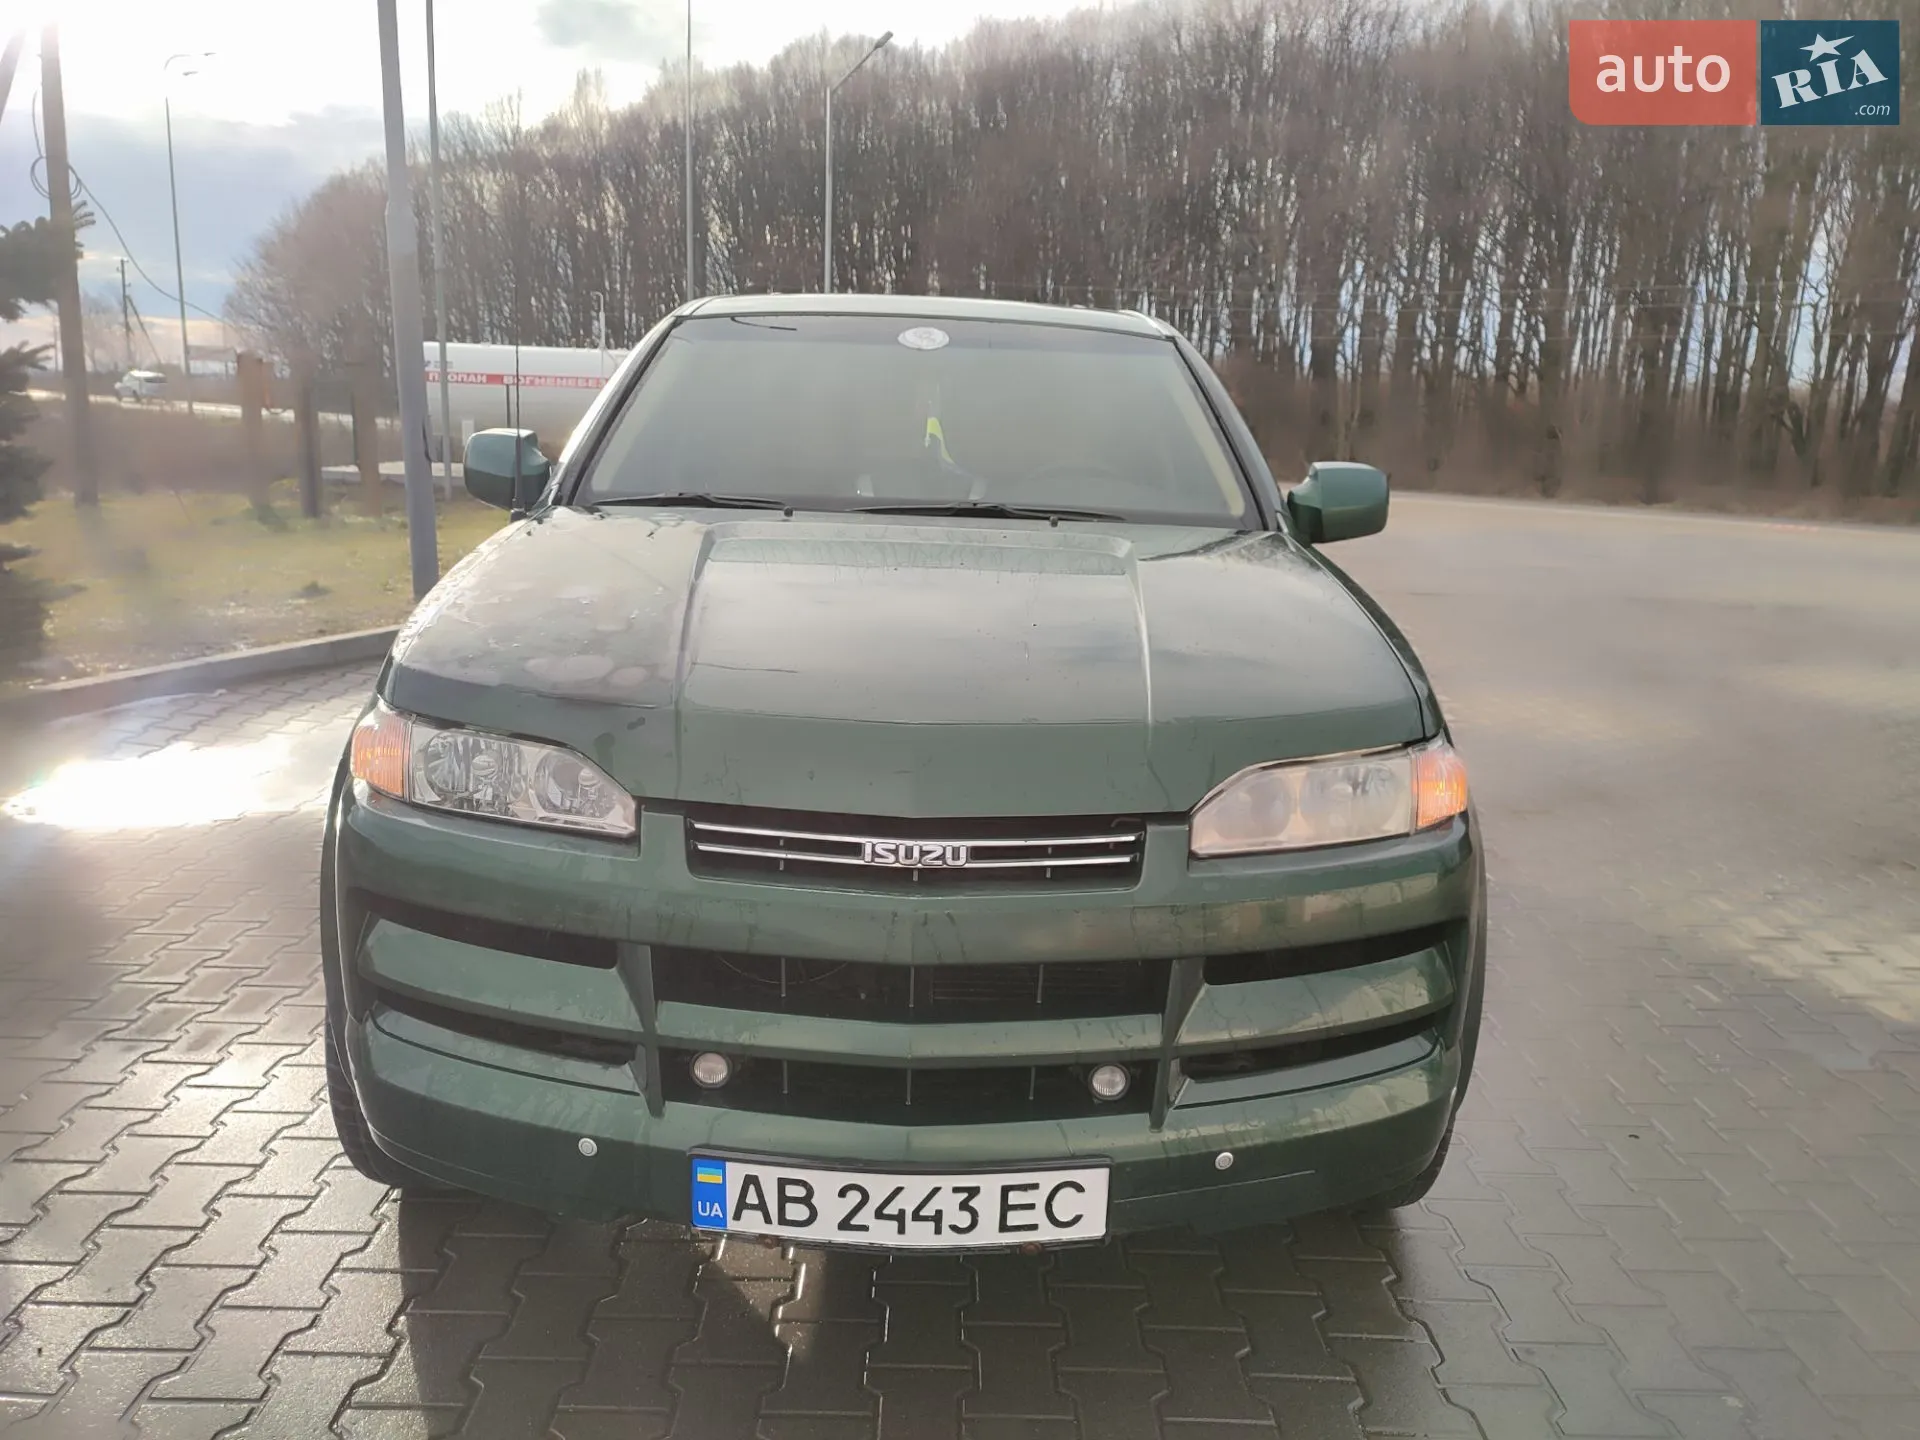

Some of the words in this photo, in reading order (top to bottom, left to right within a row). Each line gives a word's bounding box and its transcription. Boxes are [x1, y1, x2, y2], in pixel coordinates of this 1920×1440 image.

[428, 371, 487, 384] ПОПАН
[864, 841, 967, 867] ISUZU
[697, 1200, 724, 1219] UA
[732, 1173, 819, 1229] AB
[837, 1182, 981, 1236] 2443
[998, 1180, 1086, 1234] EC
